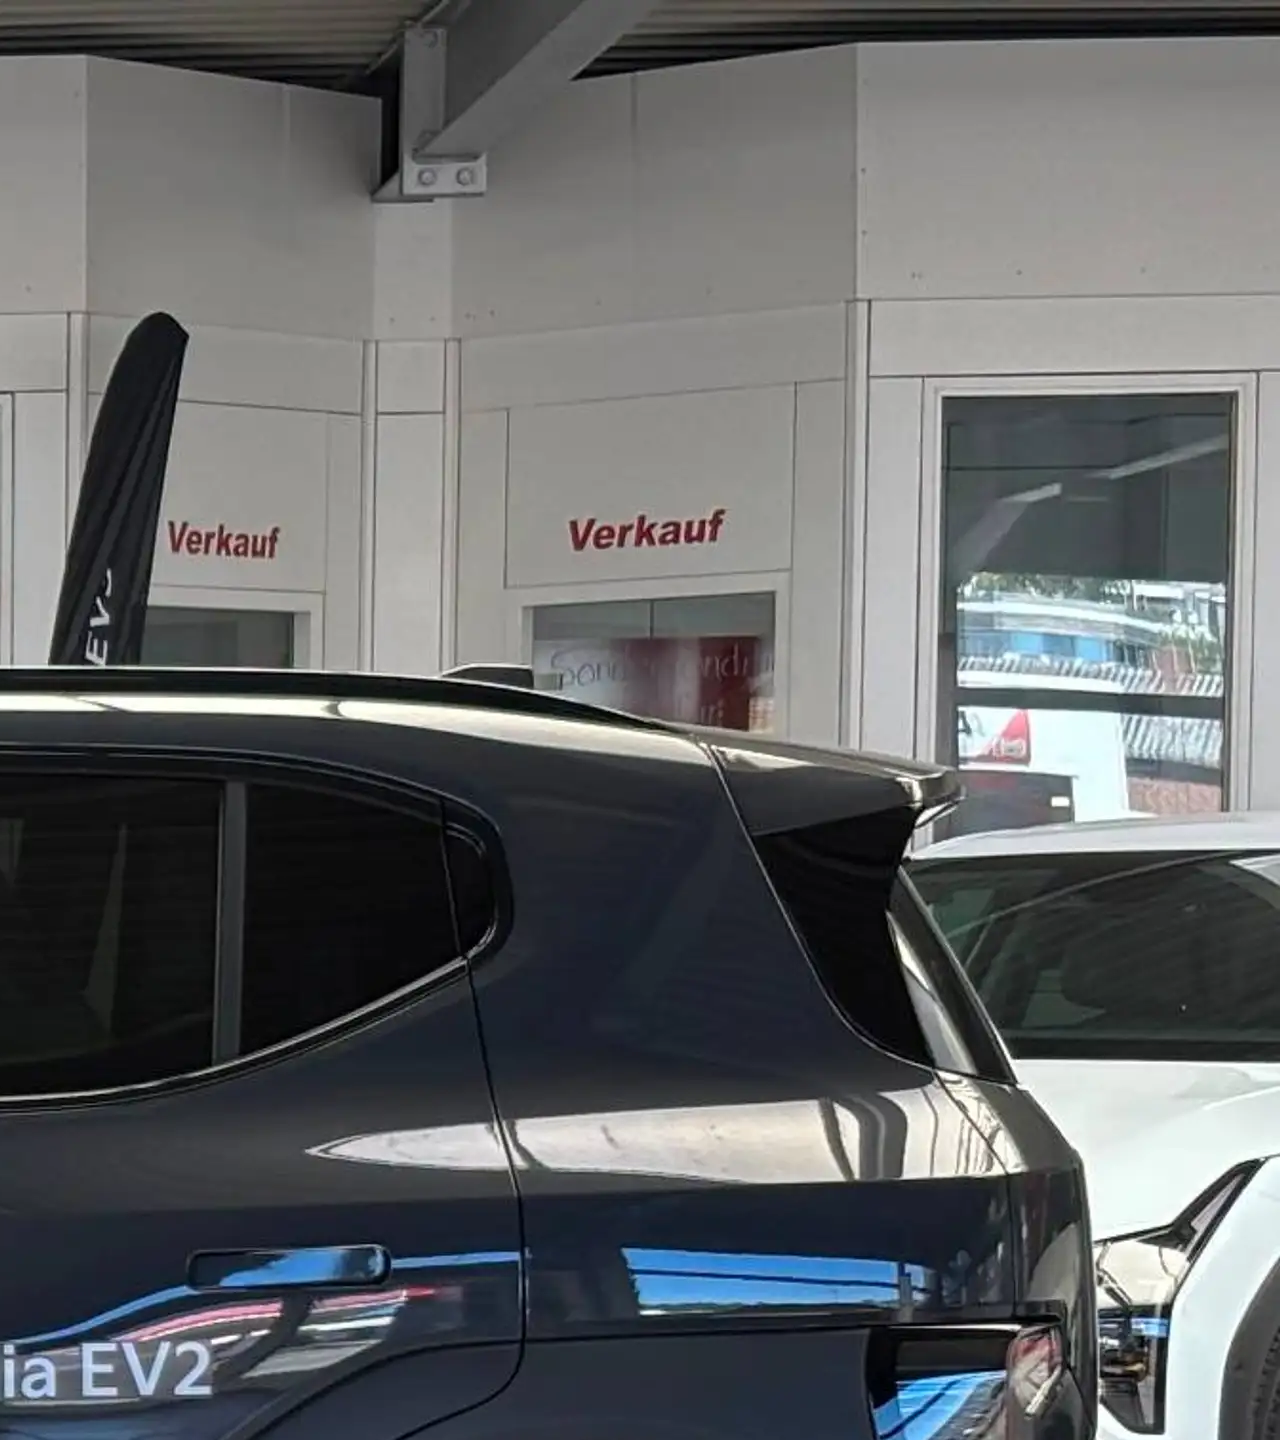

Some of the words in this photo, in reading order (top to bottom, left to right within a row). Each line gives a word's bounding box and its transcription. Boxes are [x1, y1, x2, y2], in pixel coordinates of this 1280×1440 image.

[168, 521, 281, 559] Verkauf
[569, 509, 726, 552] Verkauf
[80, 1340, 213, 1397] EV2
